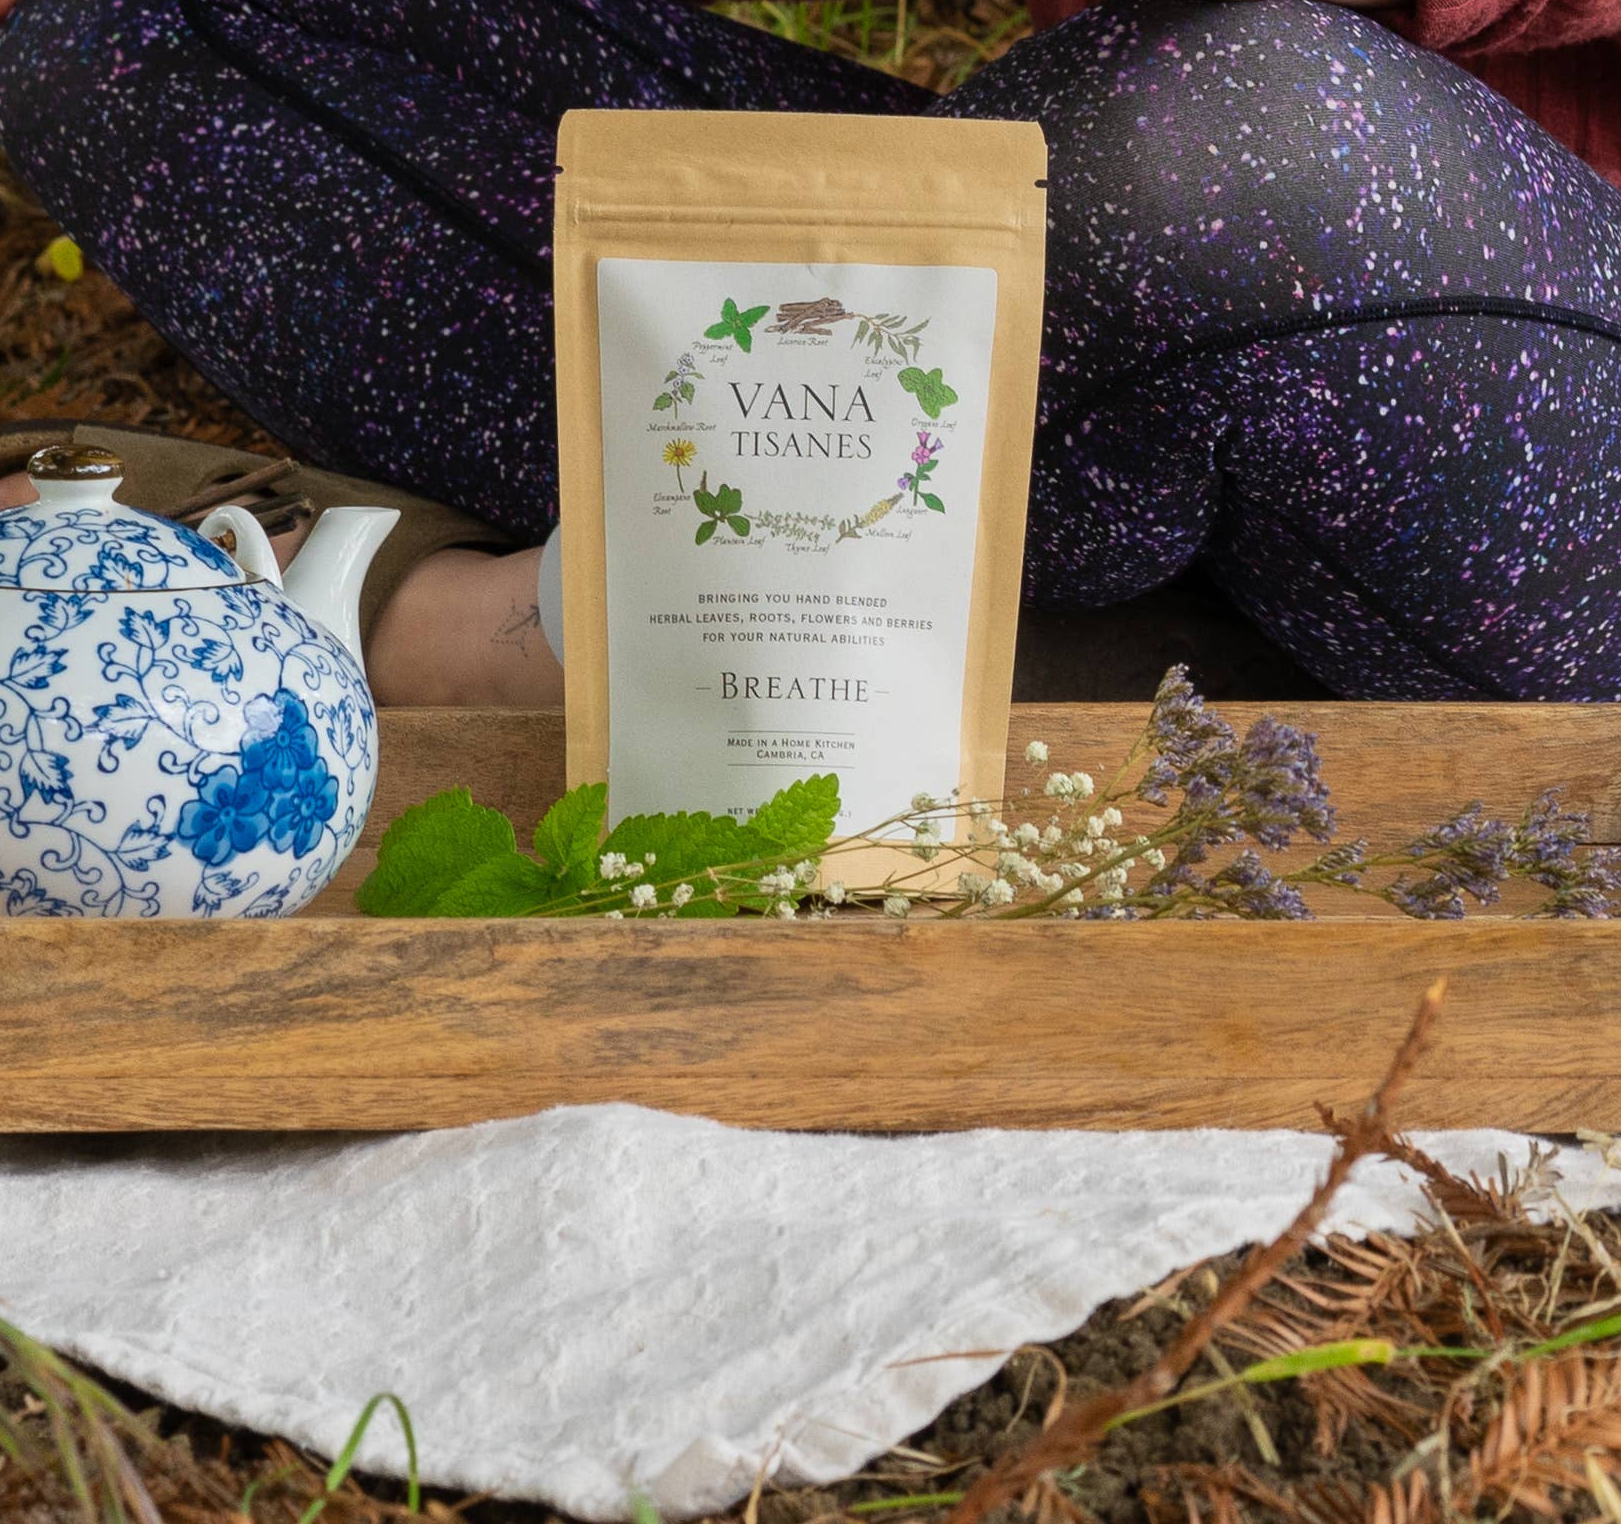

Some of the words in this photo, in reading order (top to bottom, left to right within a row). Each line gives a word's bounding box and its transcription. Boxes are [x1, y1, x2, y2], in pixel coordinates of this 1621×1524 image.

[728, 382, 876, 422] VANA
[731, 431, 872, 461] TISANES
[785, 542, 809, 555] Thyme
[698, 594, 759, 604] BRINGING
[765, 594, 790, 604] YOU
[796, 594, 830, 604] HAND
[836, 596, 887, 607] BLENDED
[649, 614, 692, 624] HERBAL
[696, 613, 744, 624] LEAVES,
[749, 613, 795, 624] ROOTS,
[801, 614, 858, 625] FLOWERS
[861, 617, 883, 627] AND
[887, 618, 933, 630] BERRIES
[703, 632, 725, 642] FOR
[730, 632, 763, 642] YOUR
[769, 632, 827, 643] NATURAL
[831, 634, 885, 646] ABILITIES
[721, 672, 869, 702] BREATHE
[727, 738, 753, 747] MADE
[757, 739, 767, 747] IN
[772, 739, 778, 747] A
[781, 738, 810, 748] HOME
[815, 739, 855, 749] KITCHEN
[756, 749, 807, 760] CAMBRIA,
[811, 751, 824, 760] CA
